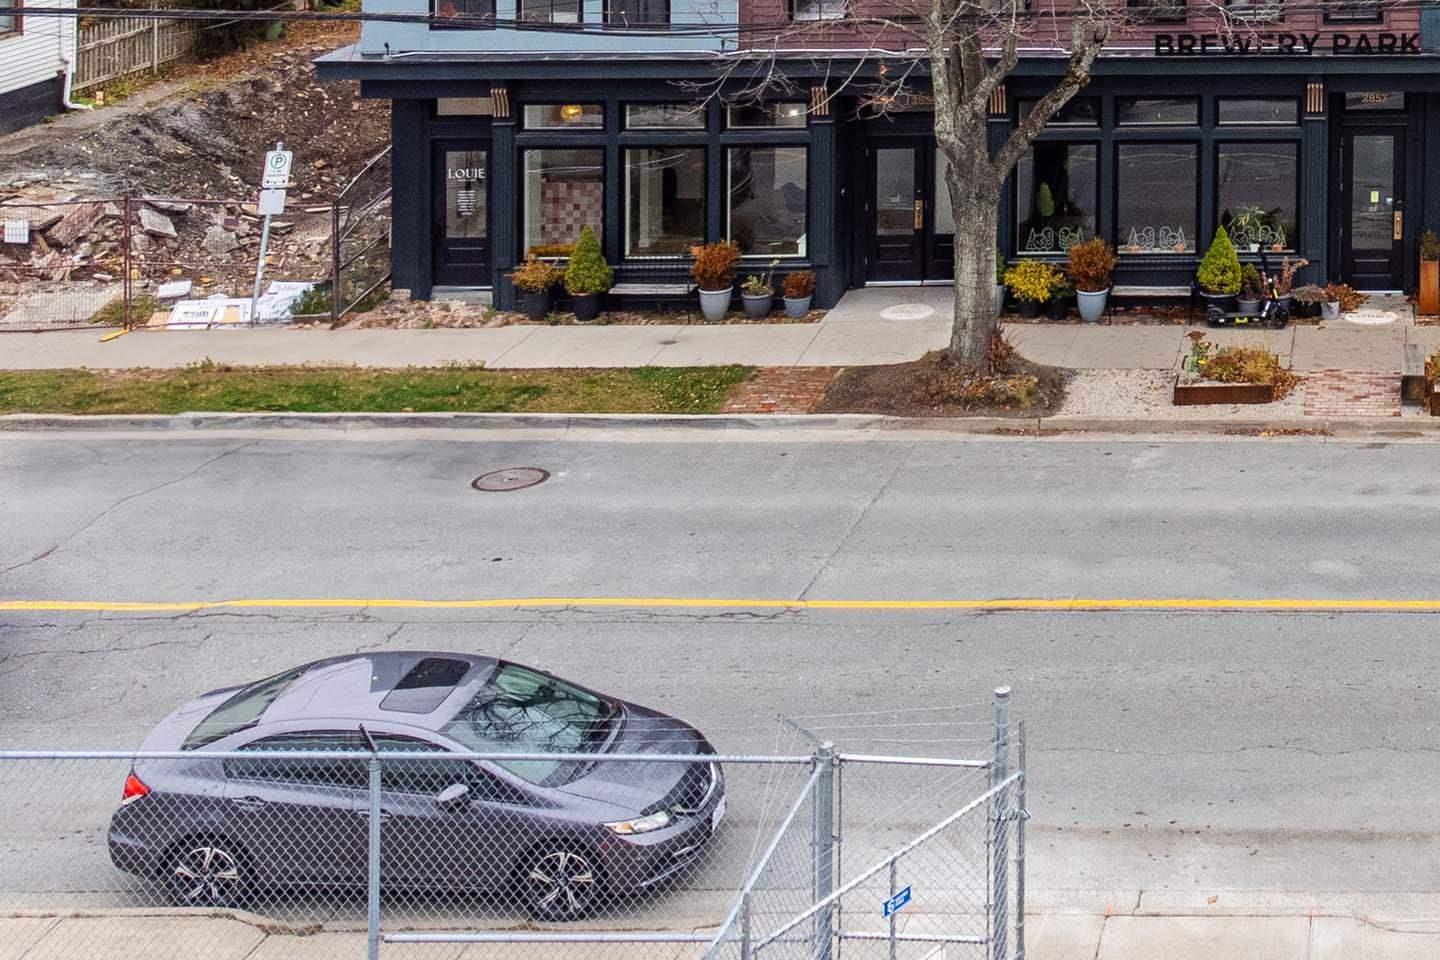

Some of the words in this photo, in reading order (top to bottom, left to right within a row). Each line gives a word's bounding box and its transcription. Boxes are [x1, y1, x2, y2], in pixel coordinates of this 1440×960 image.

[1155, 32, 1320, 56] BREWERY
[1333, 32, 1422, 56] PARK
[448, 168, 486, 179] LOUIE
